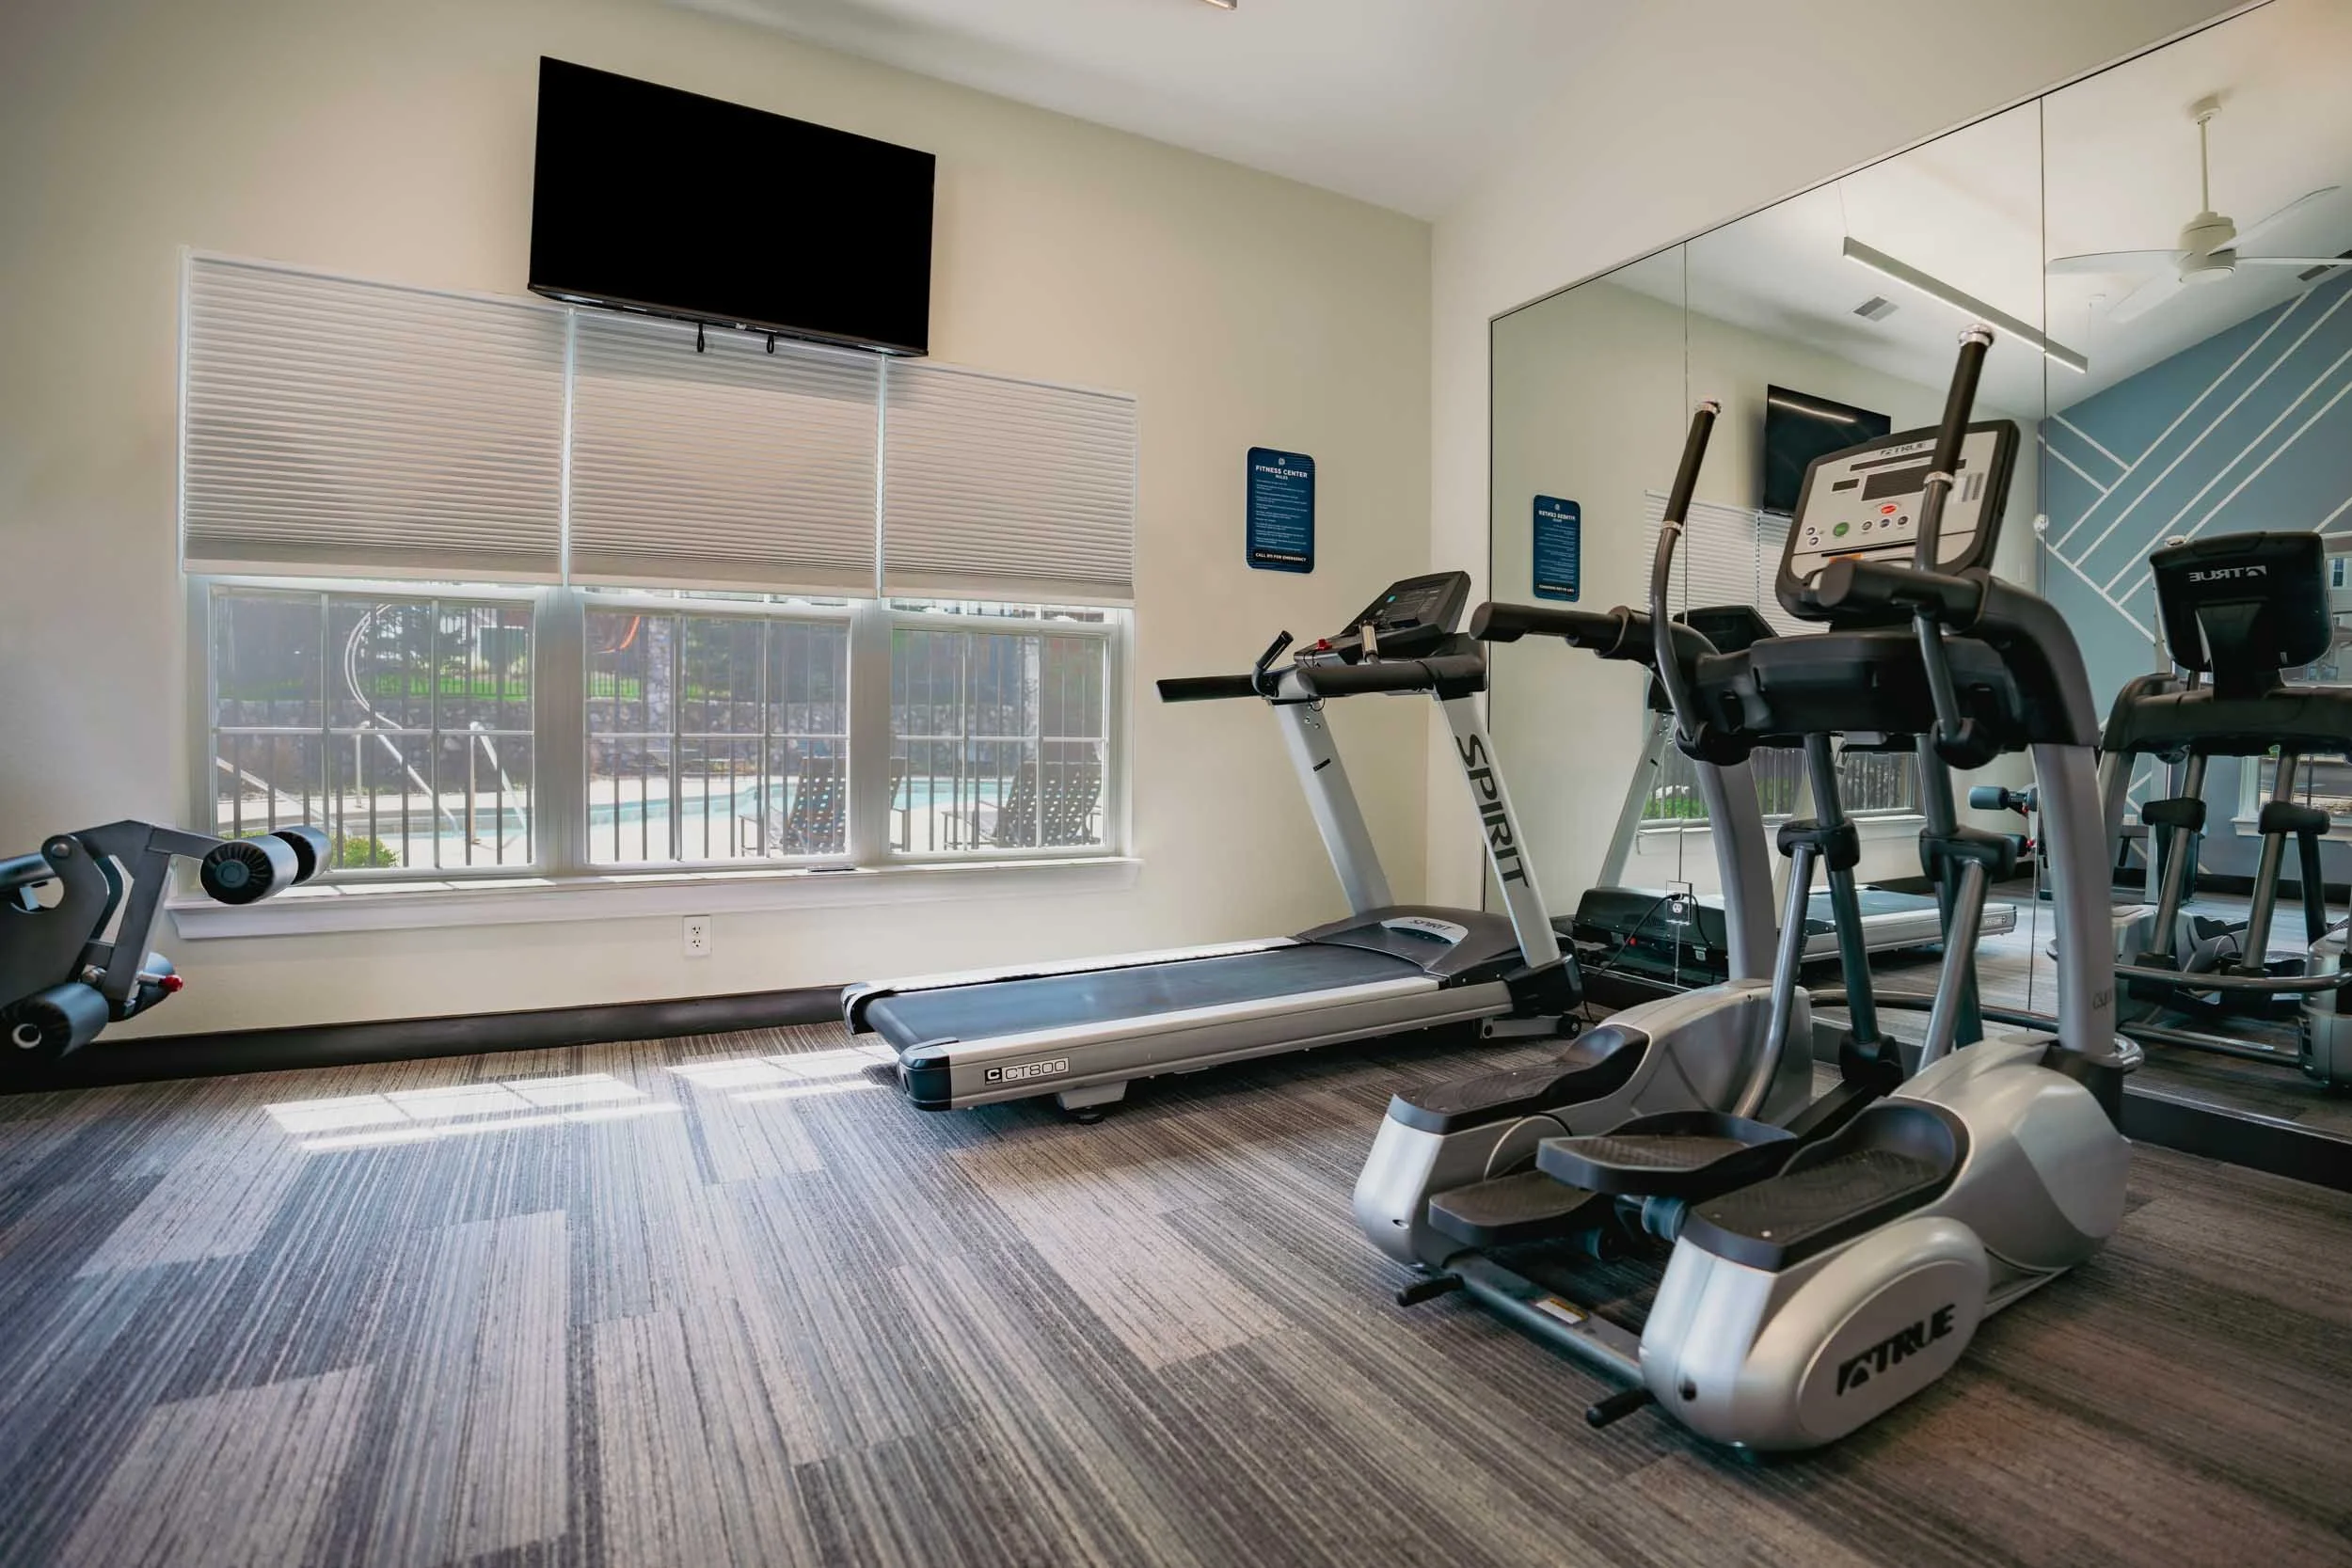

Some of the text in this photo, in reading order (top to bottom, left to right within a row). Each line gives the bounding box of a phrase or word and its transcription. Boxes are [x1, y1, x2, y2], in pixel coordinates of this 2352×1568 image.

[1255, 465, 1308, 479] FITNESS CENTER
[1455, 733, 1530, 889] SPIRIT
[1005, 1060, 1067, 1080] CT800
[1868, 1304, 1956, 1374] TRUE
